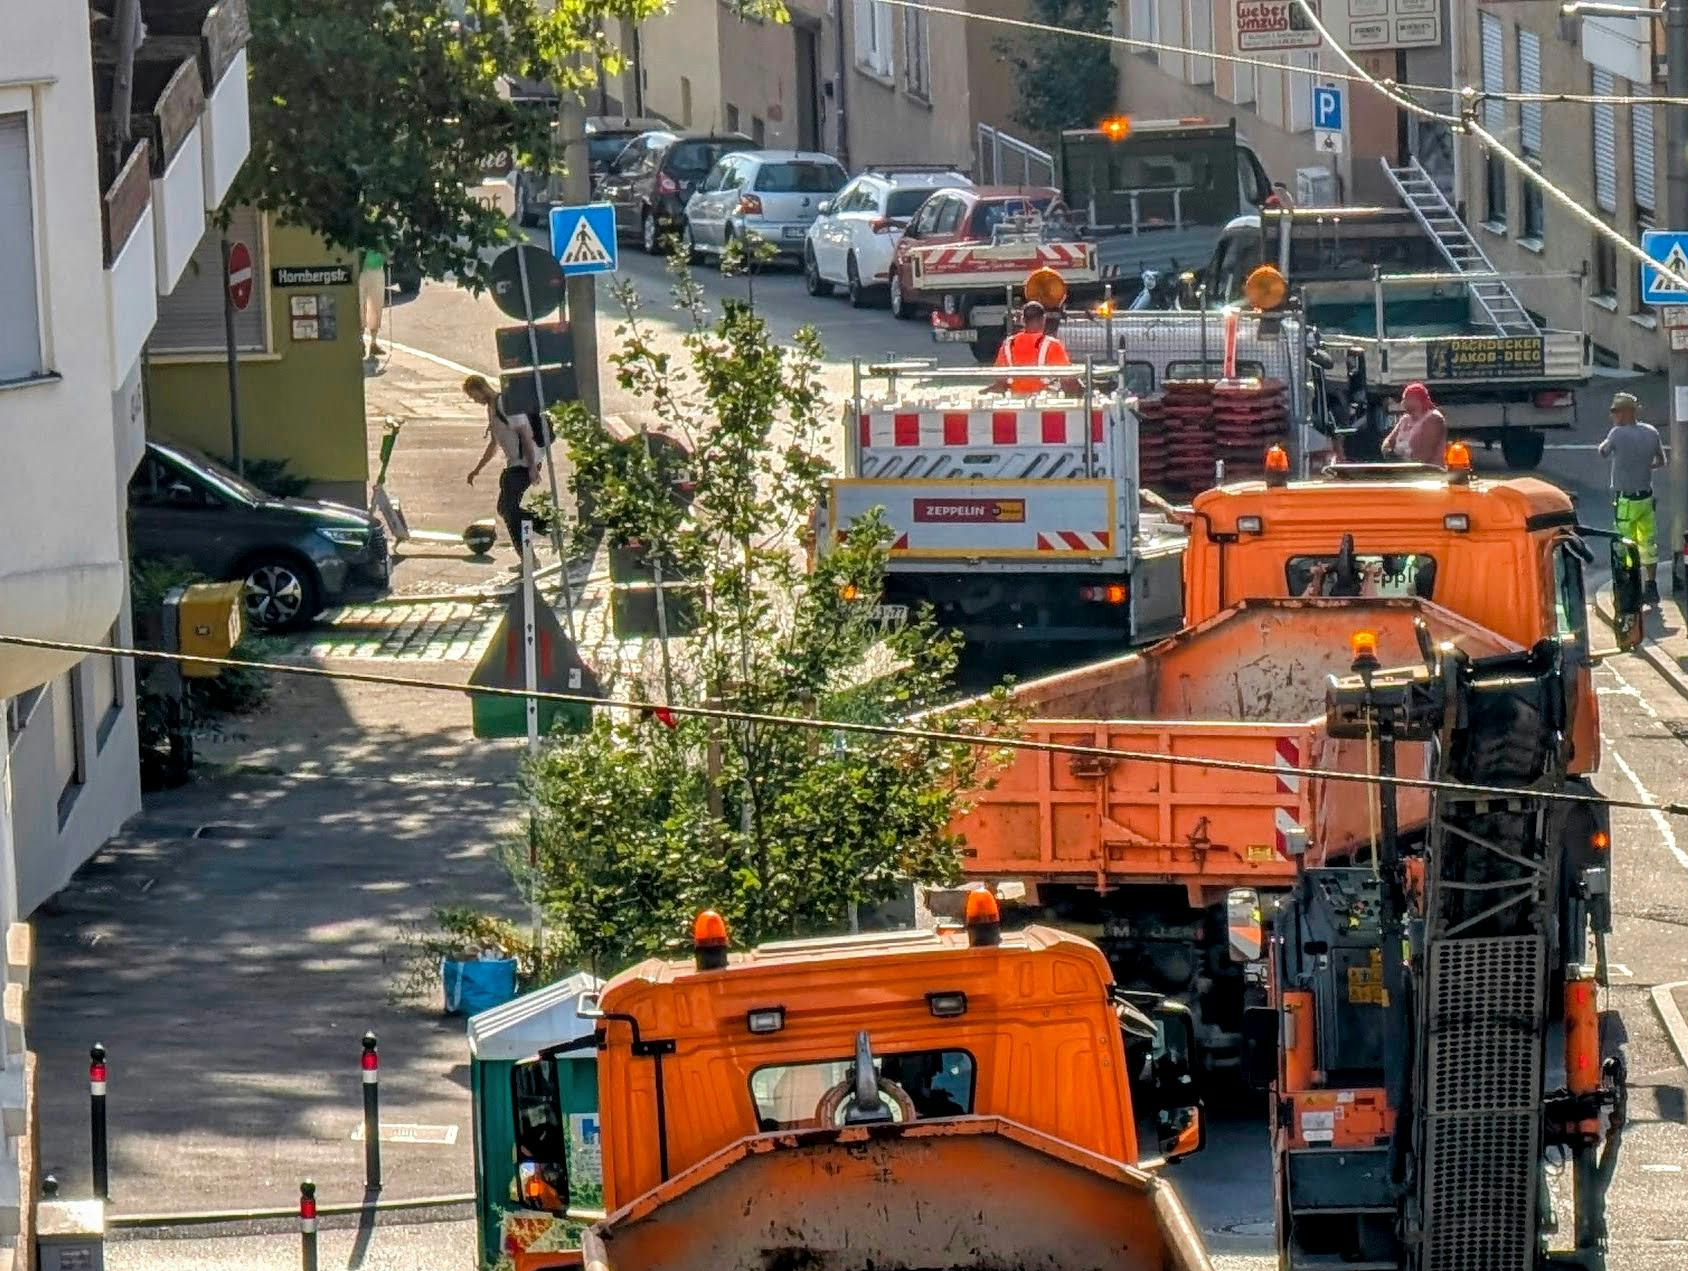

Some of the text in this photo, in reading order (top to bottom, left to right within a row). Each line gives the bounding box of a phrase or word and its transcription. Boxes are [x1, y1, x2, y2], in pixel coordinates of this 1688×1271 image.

[1320, 92, 1335, 124] P
[278, 267, 347, 285] Hornbergstr.
[926, 505, 985, 516] ZEPPELIN
